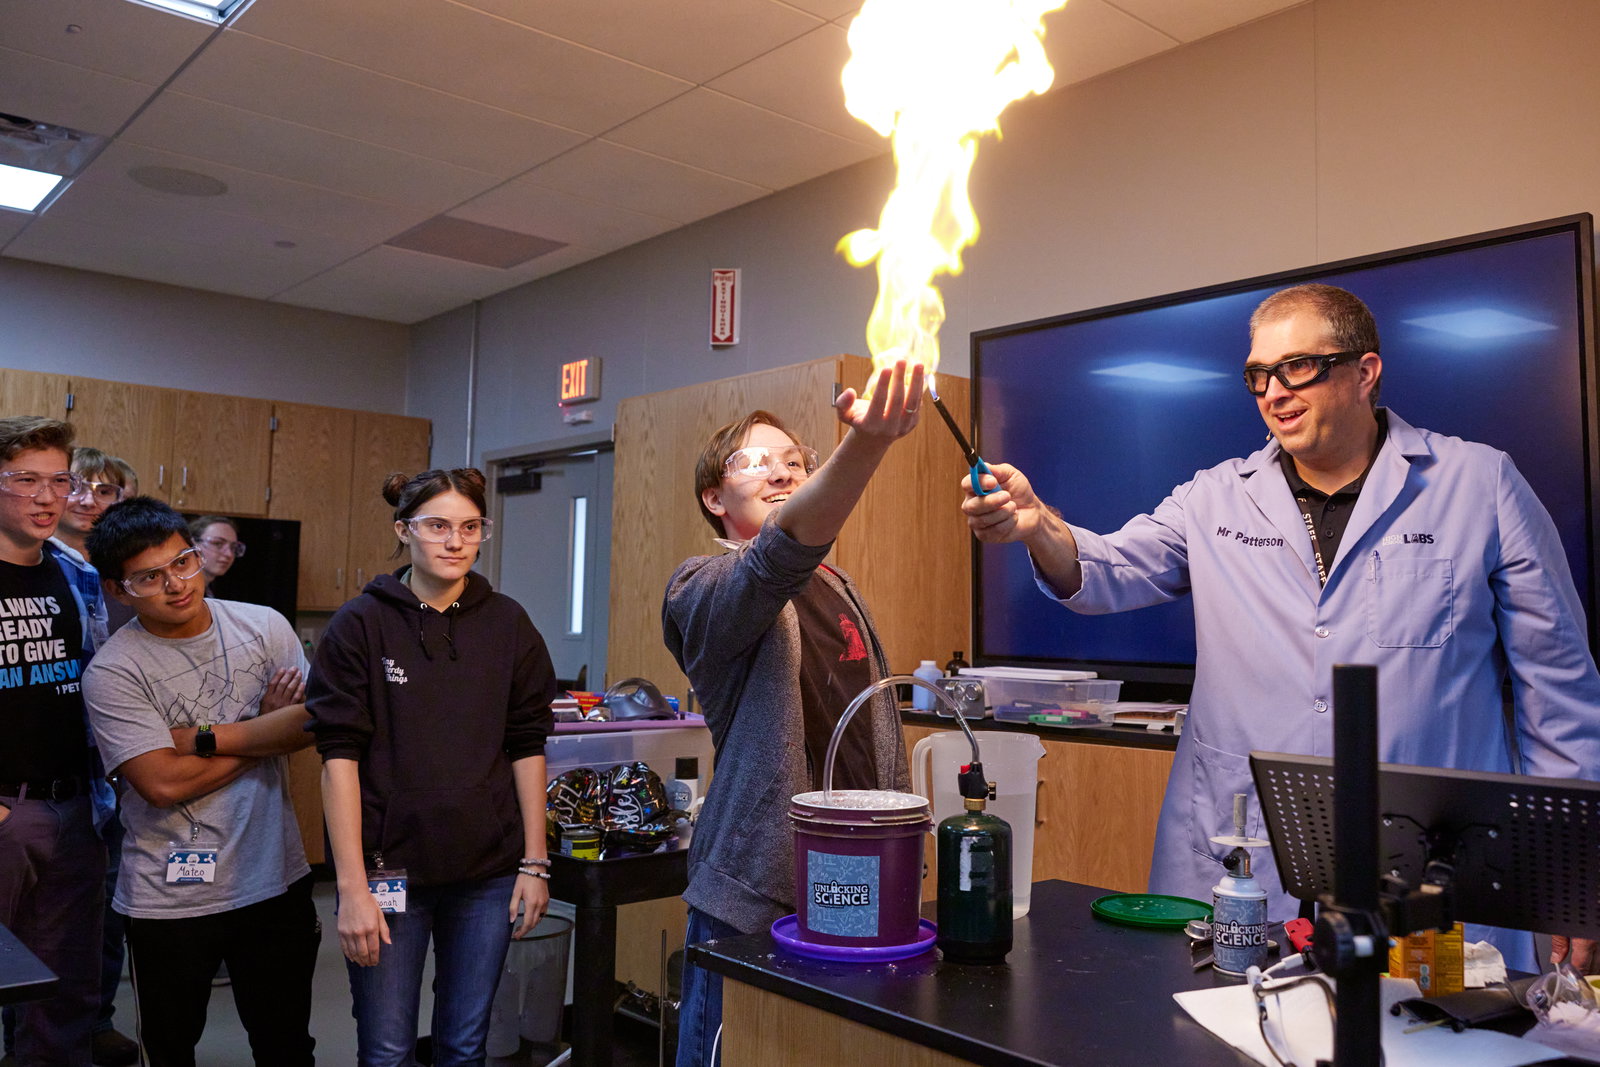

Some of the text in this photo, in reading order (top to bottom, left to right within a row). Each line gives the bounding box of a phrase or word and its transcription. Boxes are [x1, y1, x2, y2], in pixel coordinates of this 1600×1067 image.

[561, 360, 588, 400] EXIT
[1217, 526, 1284, 547] Mr Patterson
[1303, 513, 1317, 541] STAFF
[1315, 552, 1328, 583] STAFF
[0, 596, 61, 618] LWAYS
[24, 639, 66, 663] GIVE
[0, 659, 81, 689] AN ANSW
[176, 866, 205, 877] Mateo
[814, 881, 869, 893] UNLOCKING
[815, 893, 869, 905] SCIENCE
[1215, 921, 1265, 934] UNLOCKING
[1215, 931, 1266, 946] SCIENCE
